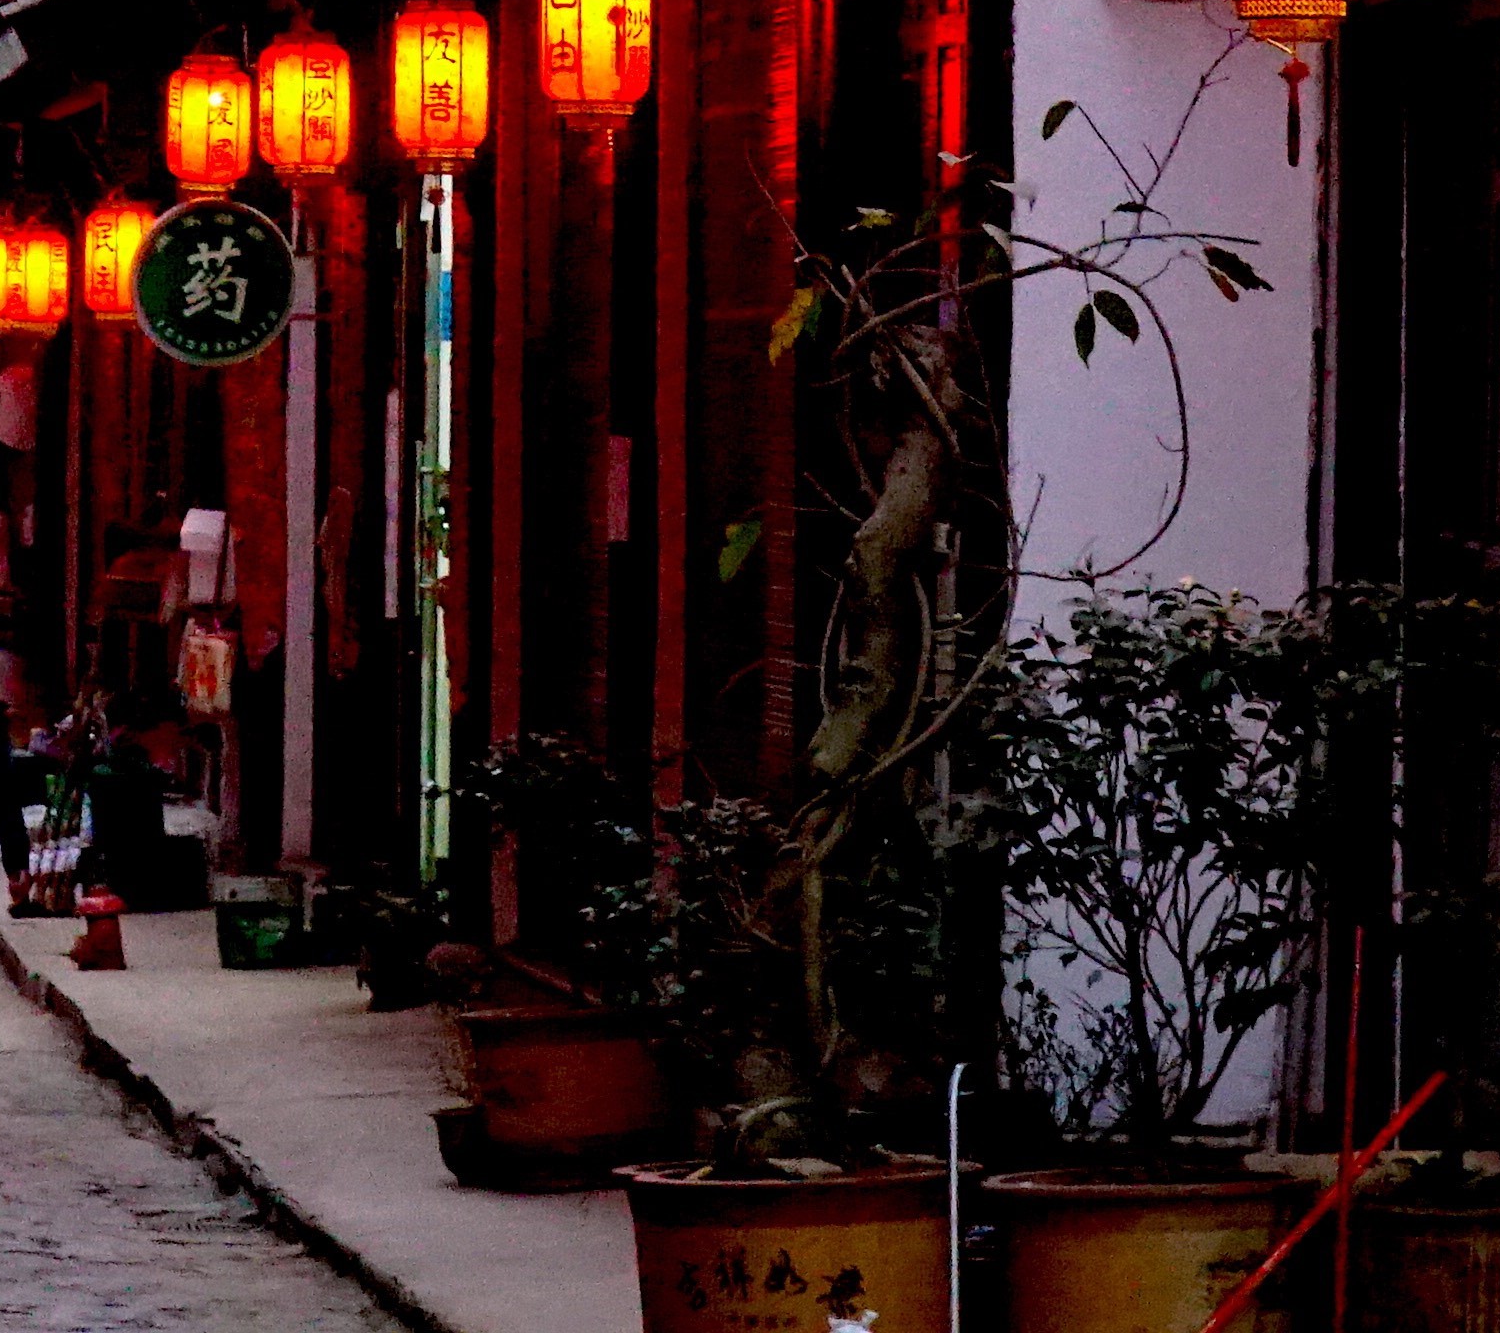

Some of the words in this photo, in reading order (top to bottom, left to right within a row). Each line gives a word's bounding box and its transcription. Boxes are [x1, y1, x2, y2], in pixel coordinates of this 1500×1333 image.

[306, 59, 333, 140] 豆沙關
[426, 30, 457, 121] 友善
[182, 236, 248, 323] 药
